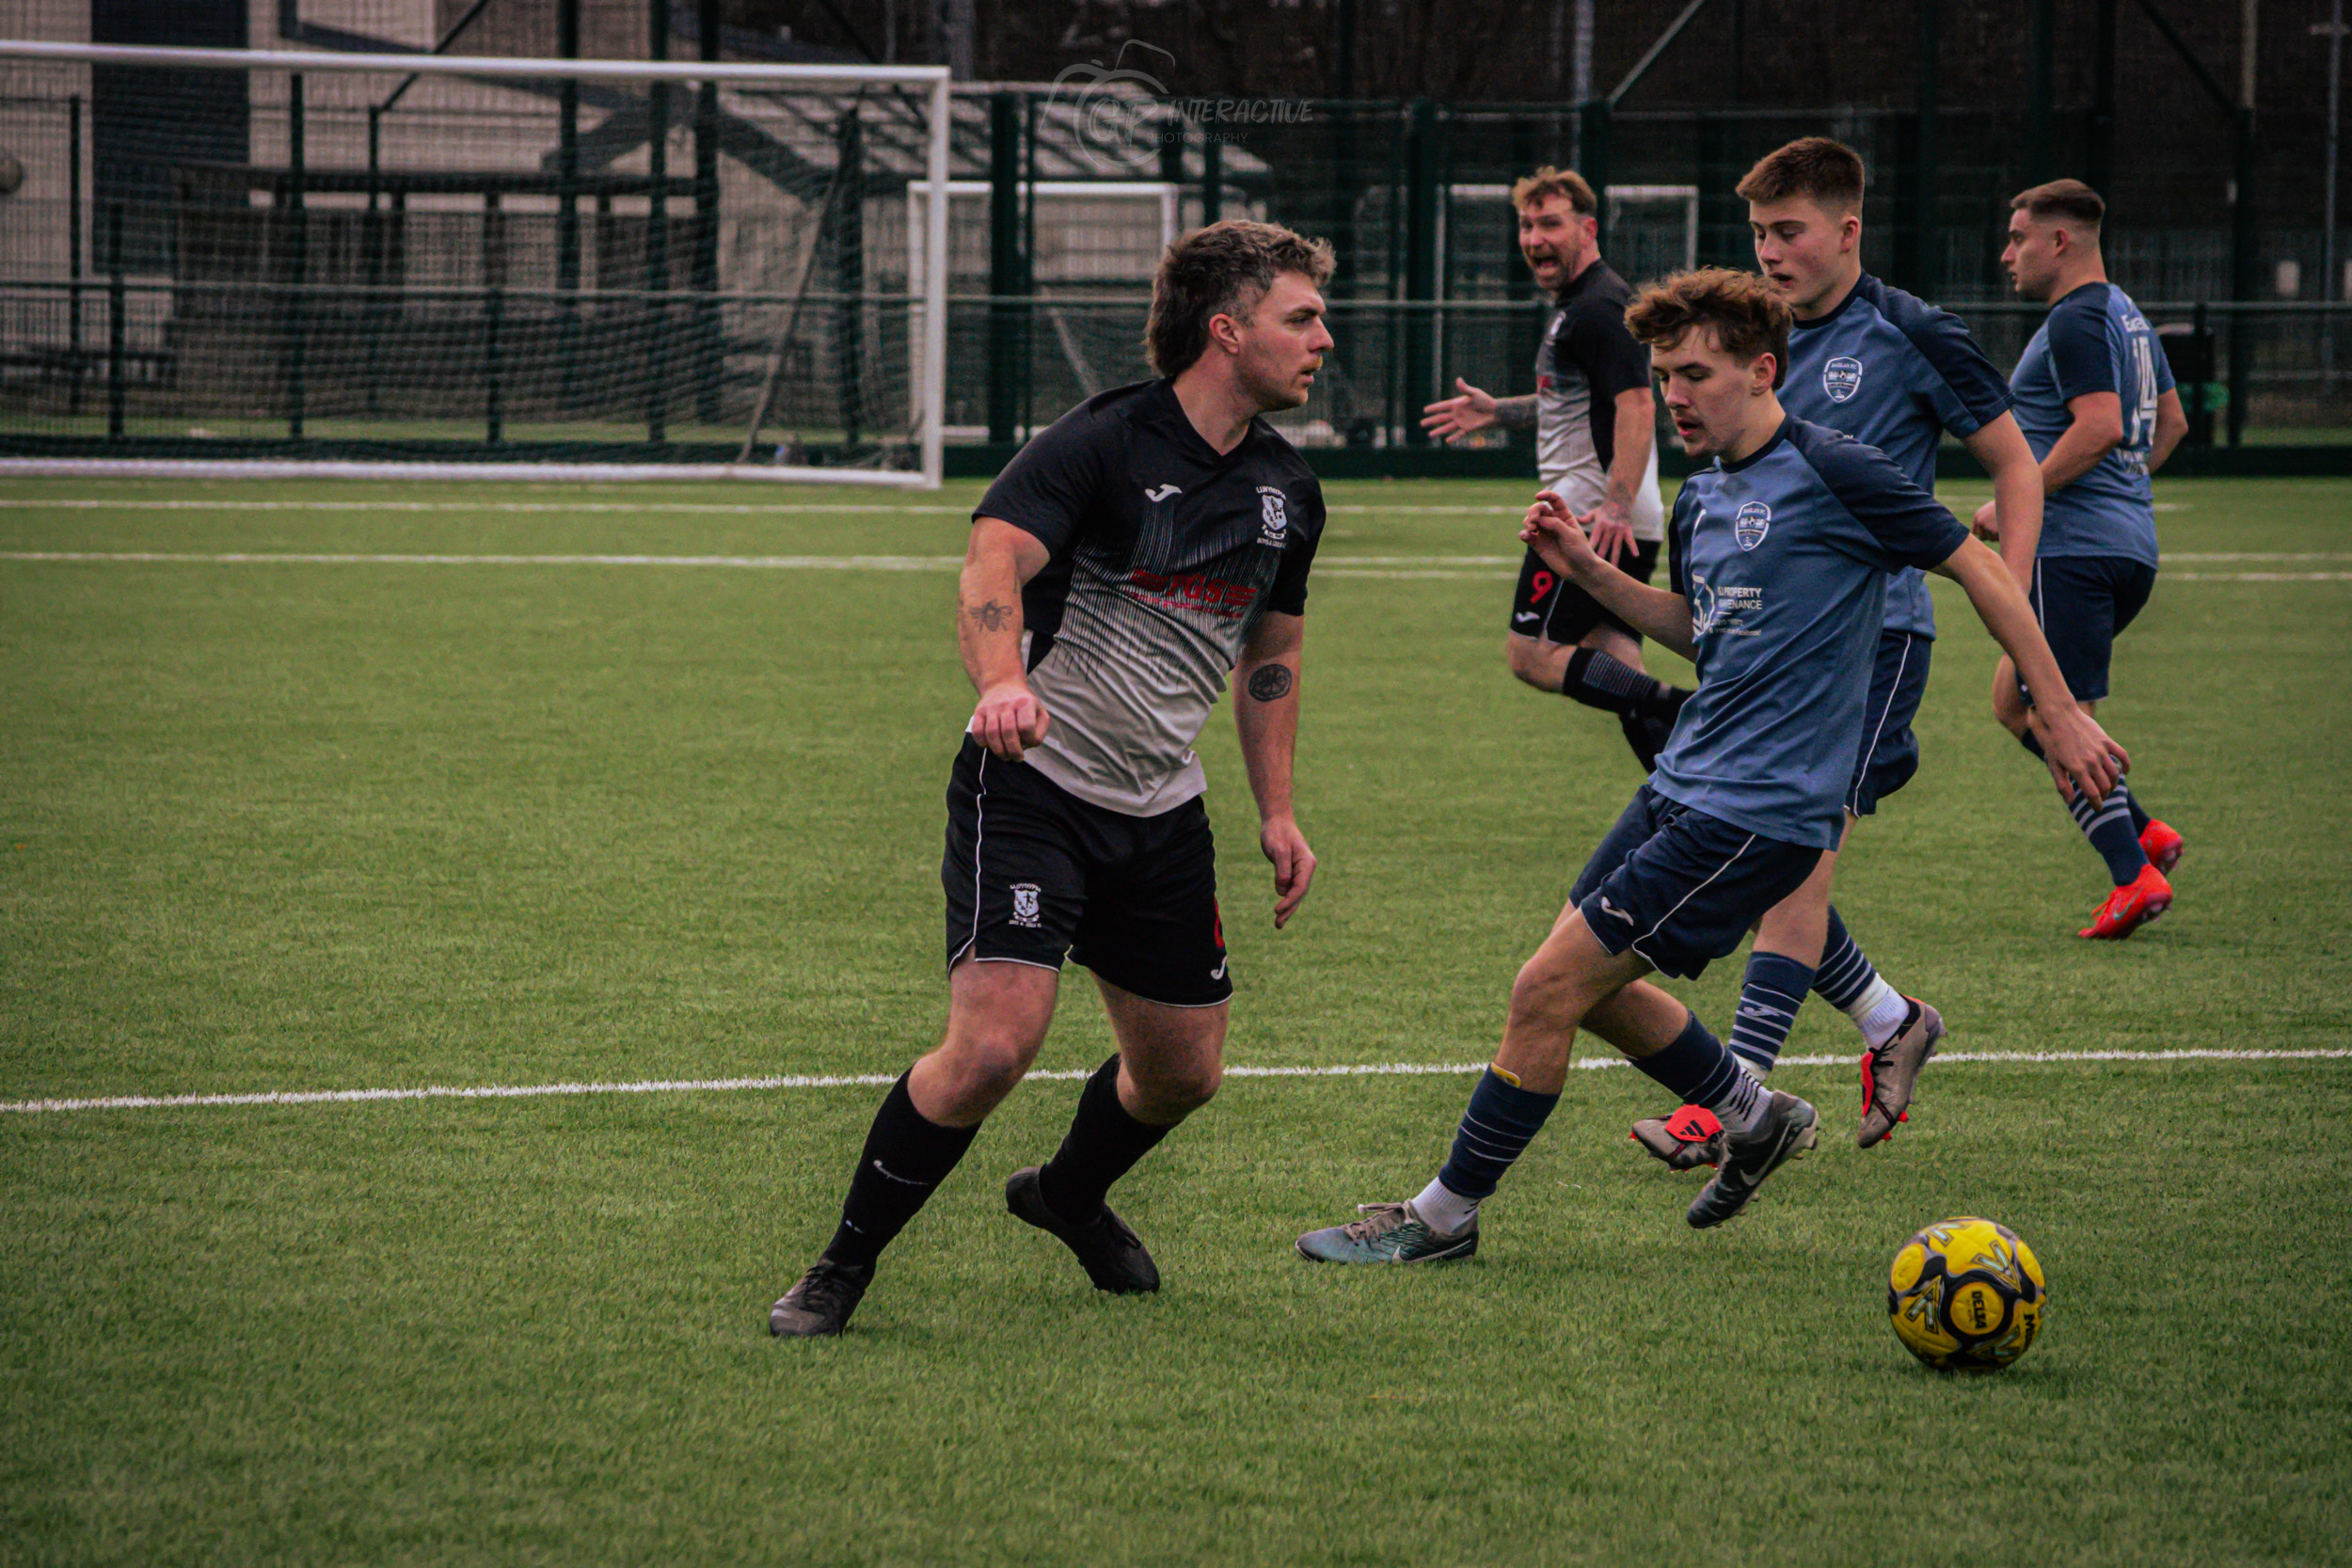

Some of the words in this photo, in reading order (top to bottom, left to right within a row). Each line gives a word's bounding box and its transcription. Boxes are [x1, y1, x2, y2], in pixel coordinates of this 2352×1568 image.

[2131, 336, 2156, 446] 14
[1167, 573, 1228, 603] PGS
[1530, 570, 1554, 605] 9
[1972, 1291, 1987, 1329] DELTA
